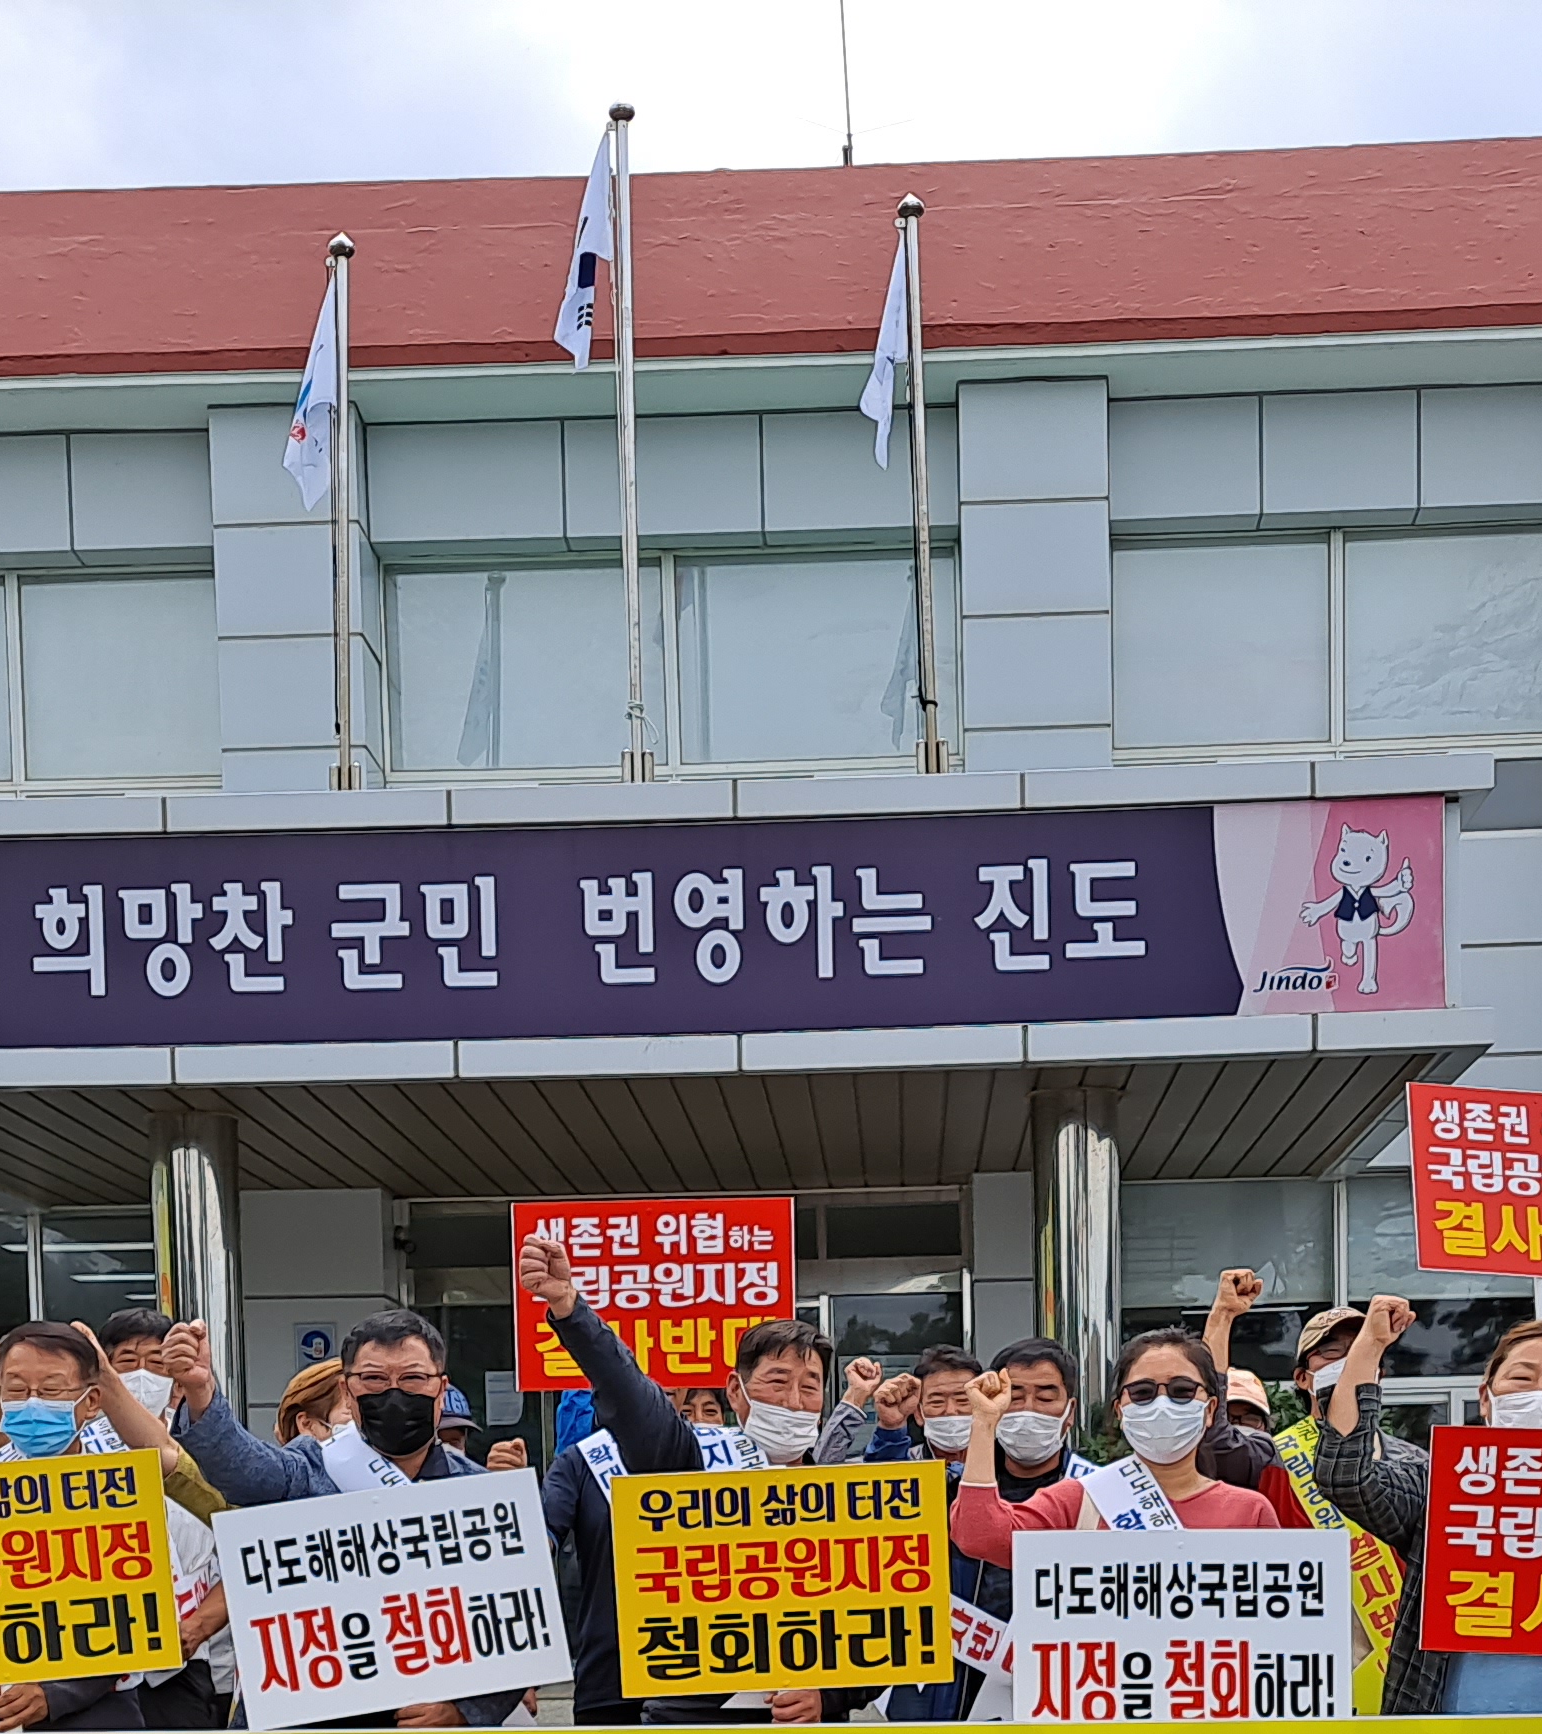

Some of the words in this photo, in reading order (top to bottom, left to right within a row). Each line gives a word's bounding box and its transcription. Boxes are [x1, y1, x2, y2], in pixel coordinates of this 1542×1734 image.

[32, 880, 294, 999] 희망찬
[330, 874, 501, 991] 군민
[578, 864, 934, 986] 번영하는
[972, 856, 1147, 974] 진도
[1253, 970, 1323, 993] Jindo
[1428, 1099, 1530, 1146] 생존권
[655, 1212, 773, 1256] 위협하는
[532, 1261, 779, 1310] 립공원지정
[60, 1465, 138, 1510] 터전
[639, 1487, 751, 1532] 우리의
[760, 1482, 836, 1526] 삶의
[847, 1478, 921, 1521] 터전
[240, 1501, 525, 1594] 다도해해상국립공원
[635, 1534, 931, 1604] 국립공원지정
[1034, 1560, 1324, 1620] 다도해해상국립공원
[250, 1606, 379, 1693] 지정을
[381, 1586, 551, 1676] 철회하라!
[637, 1605, 935, 1681] 철회하라!
[1032, 1640, 1154, 1720] 지정을
[1165, 1639, 1335, 1720] 철회하라!
